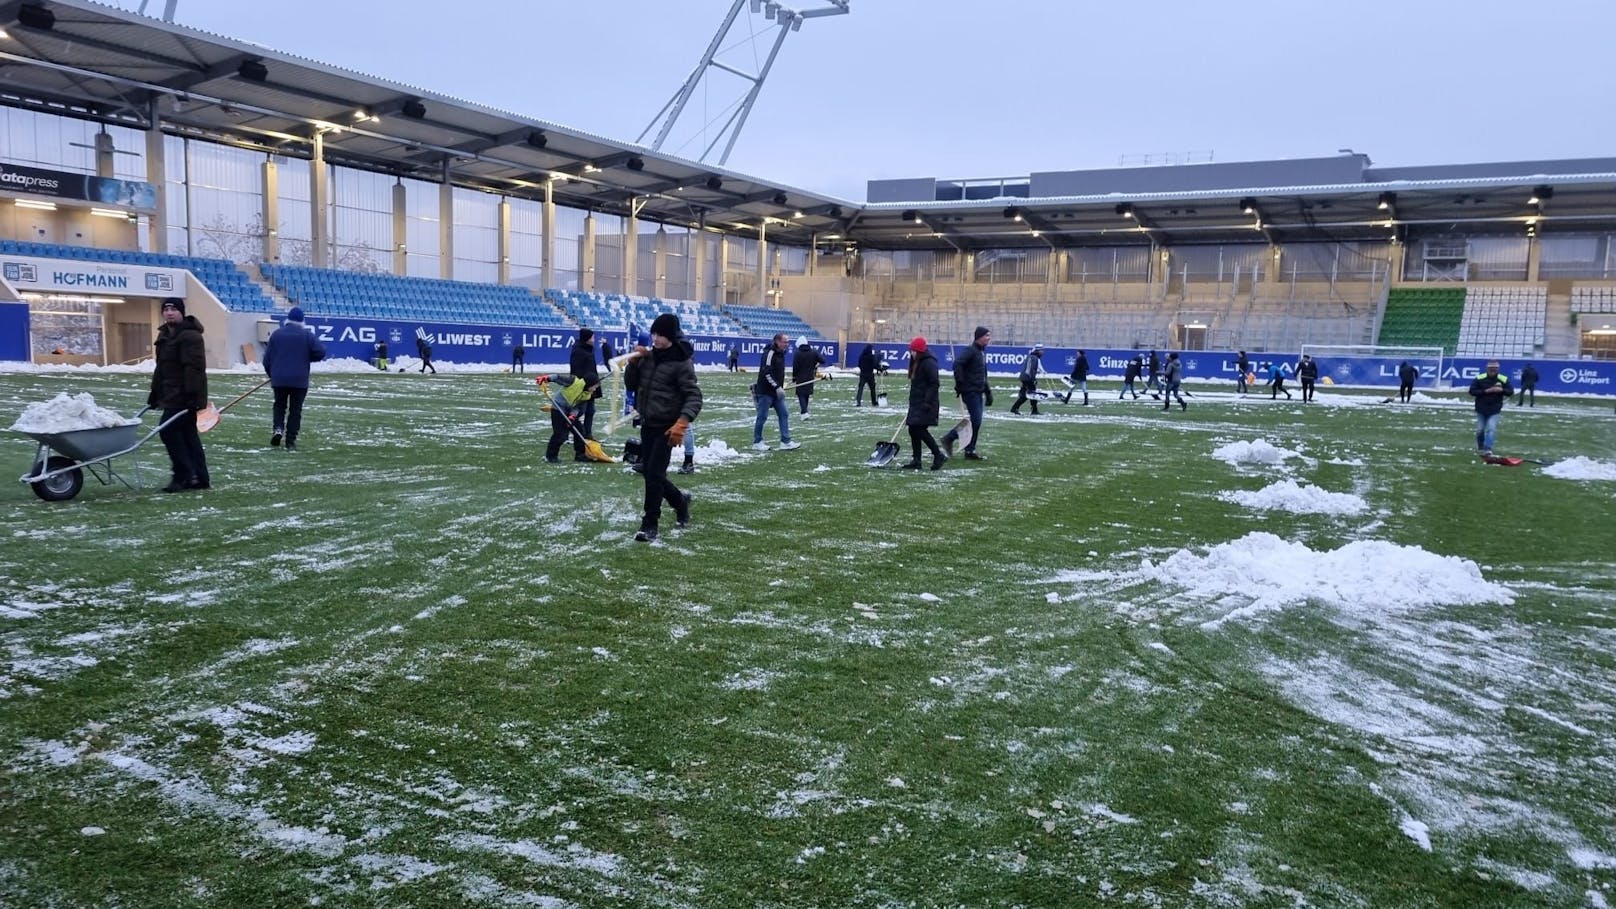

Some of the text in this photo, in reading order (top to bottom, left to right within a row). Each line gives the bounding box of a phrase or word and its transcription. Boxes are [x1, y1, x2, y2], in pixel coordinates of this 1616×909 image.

[0, 172, 59, 188] atapress
[53, 272, 127, 288] HOFMANN
[339, 325, 376, 342] AG
[437, 333, 491, 346] LIWEST
[522, 334, 563, 348] LINZ
[711, 340, 727, 352] Bier
[820, 345, 834, 355] AG
[985, 353, 1027, 365] RTGRO
[1098, 356, 1129, 369] Linze
[1379, 364, 1481, 379] LIZ AG
[1577, 376, 1610, 385] Airport
